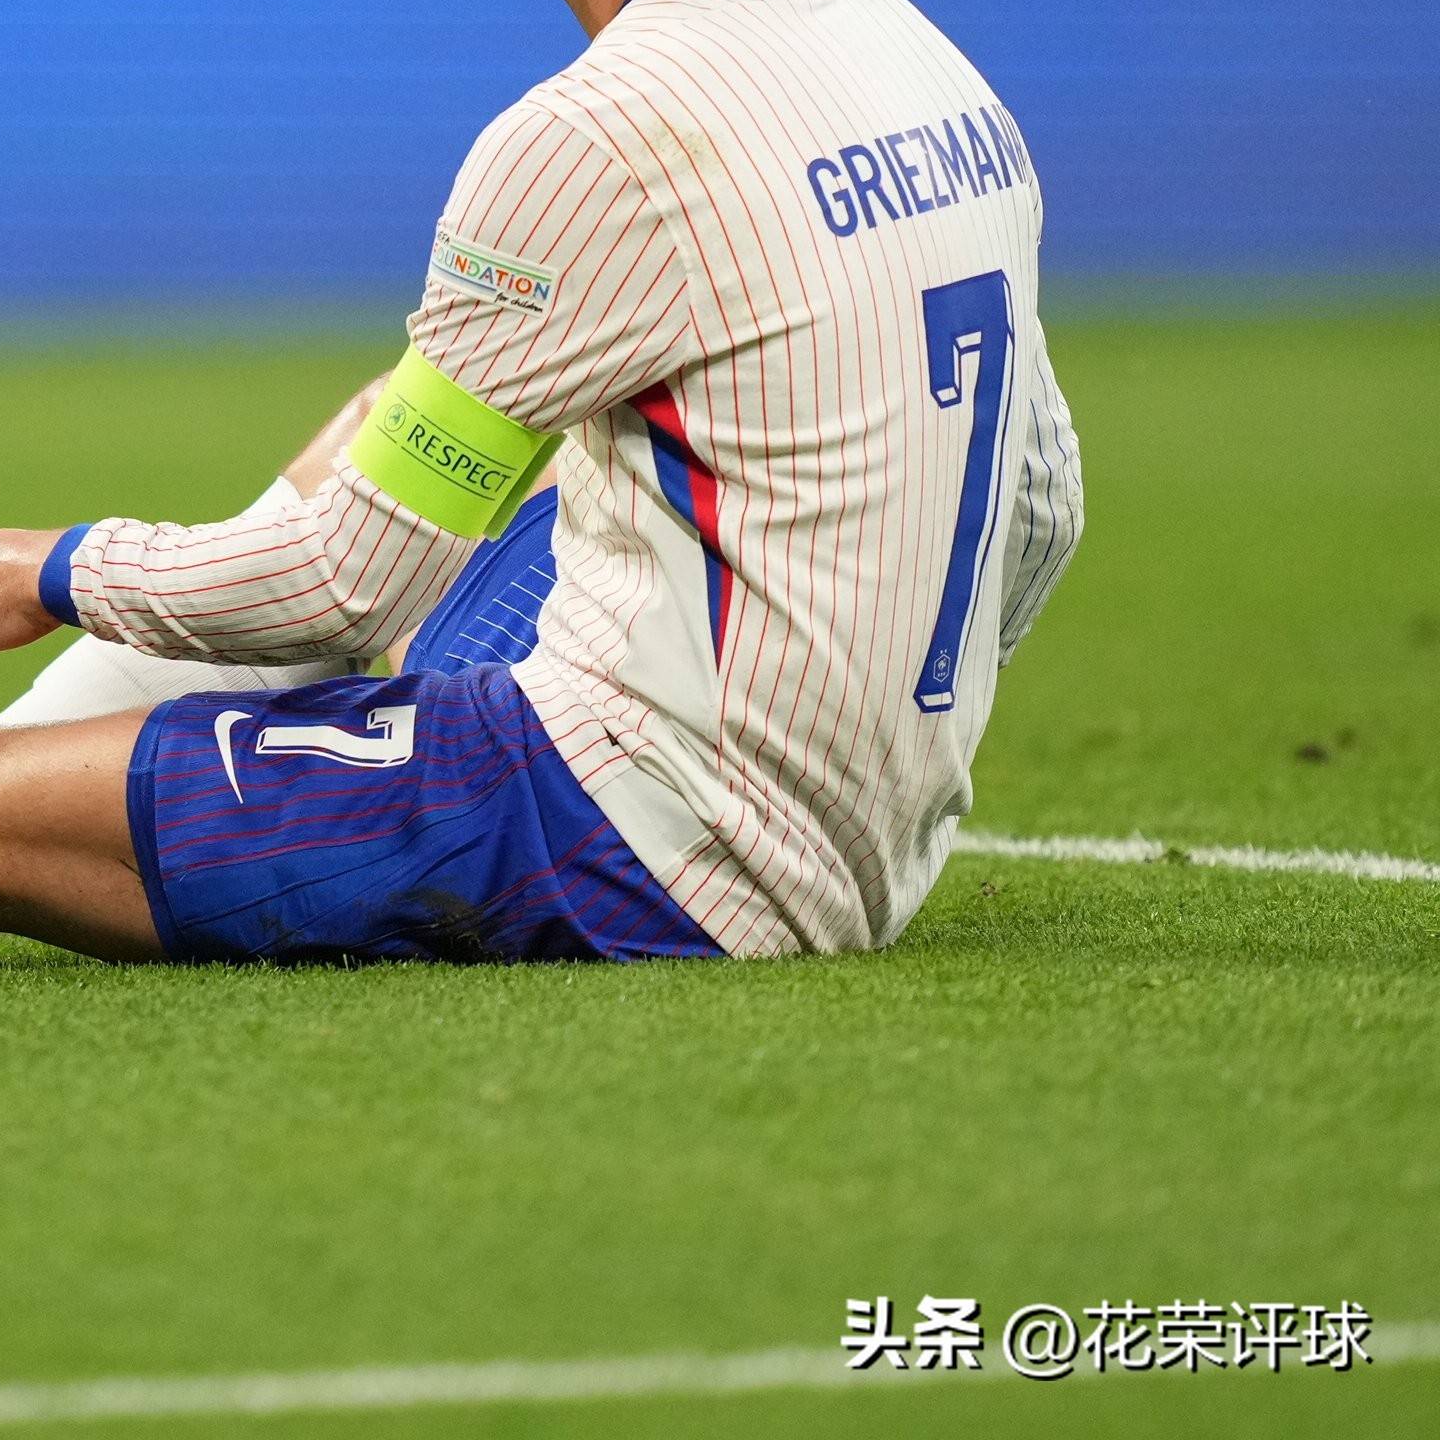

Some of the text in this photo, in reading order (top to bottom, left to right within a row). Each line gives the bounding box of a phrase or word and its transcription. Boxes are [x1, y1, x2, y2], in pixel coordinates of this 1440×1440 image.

[407, 423, 512, 493] RESPECT
[913, 269, 1015, 713] 7
[255, 704, 417, 768] 7
